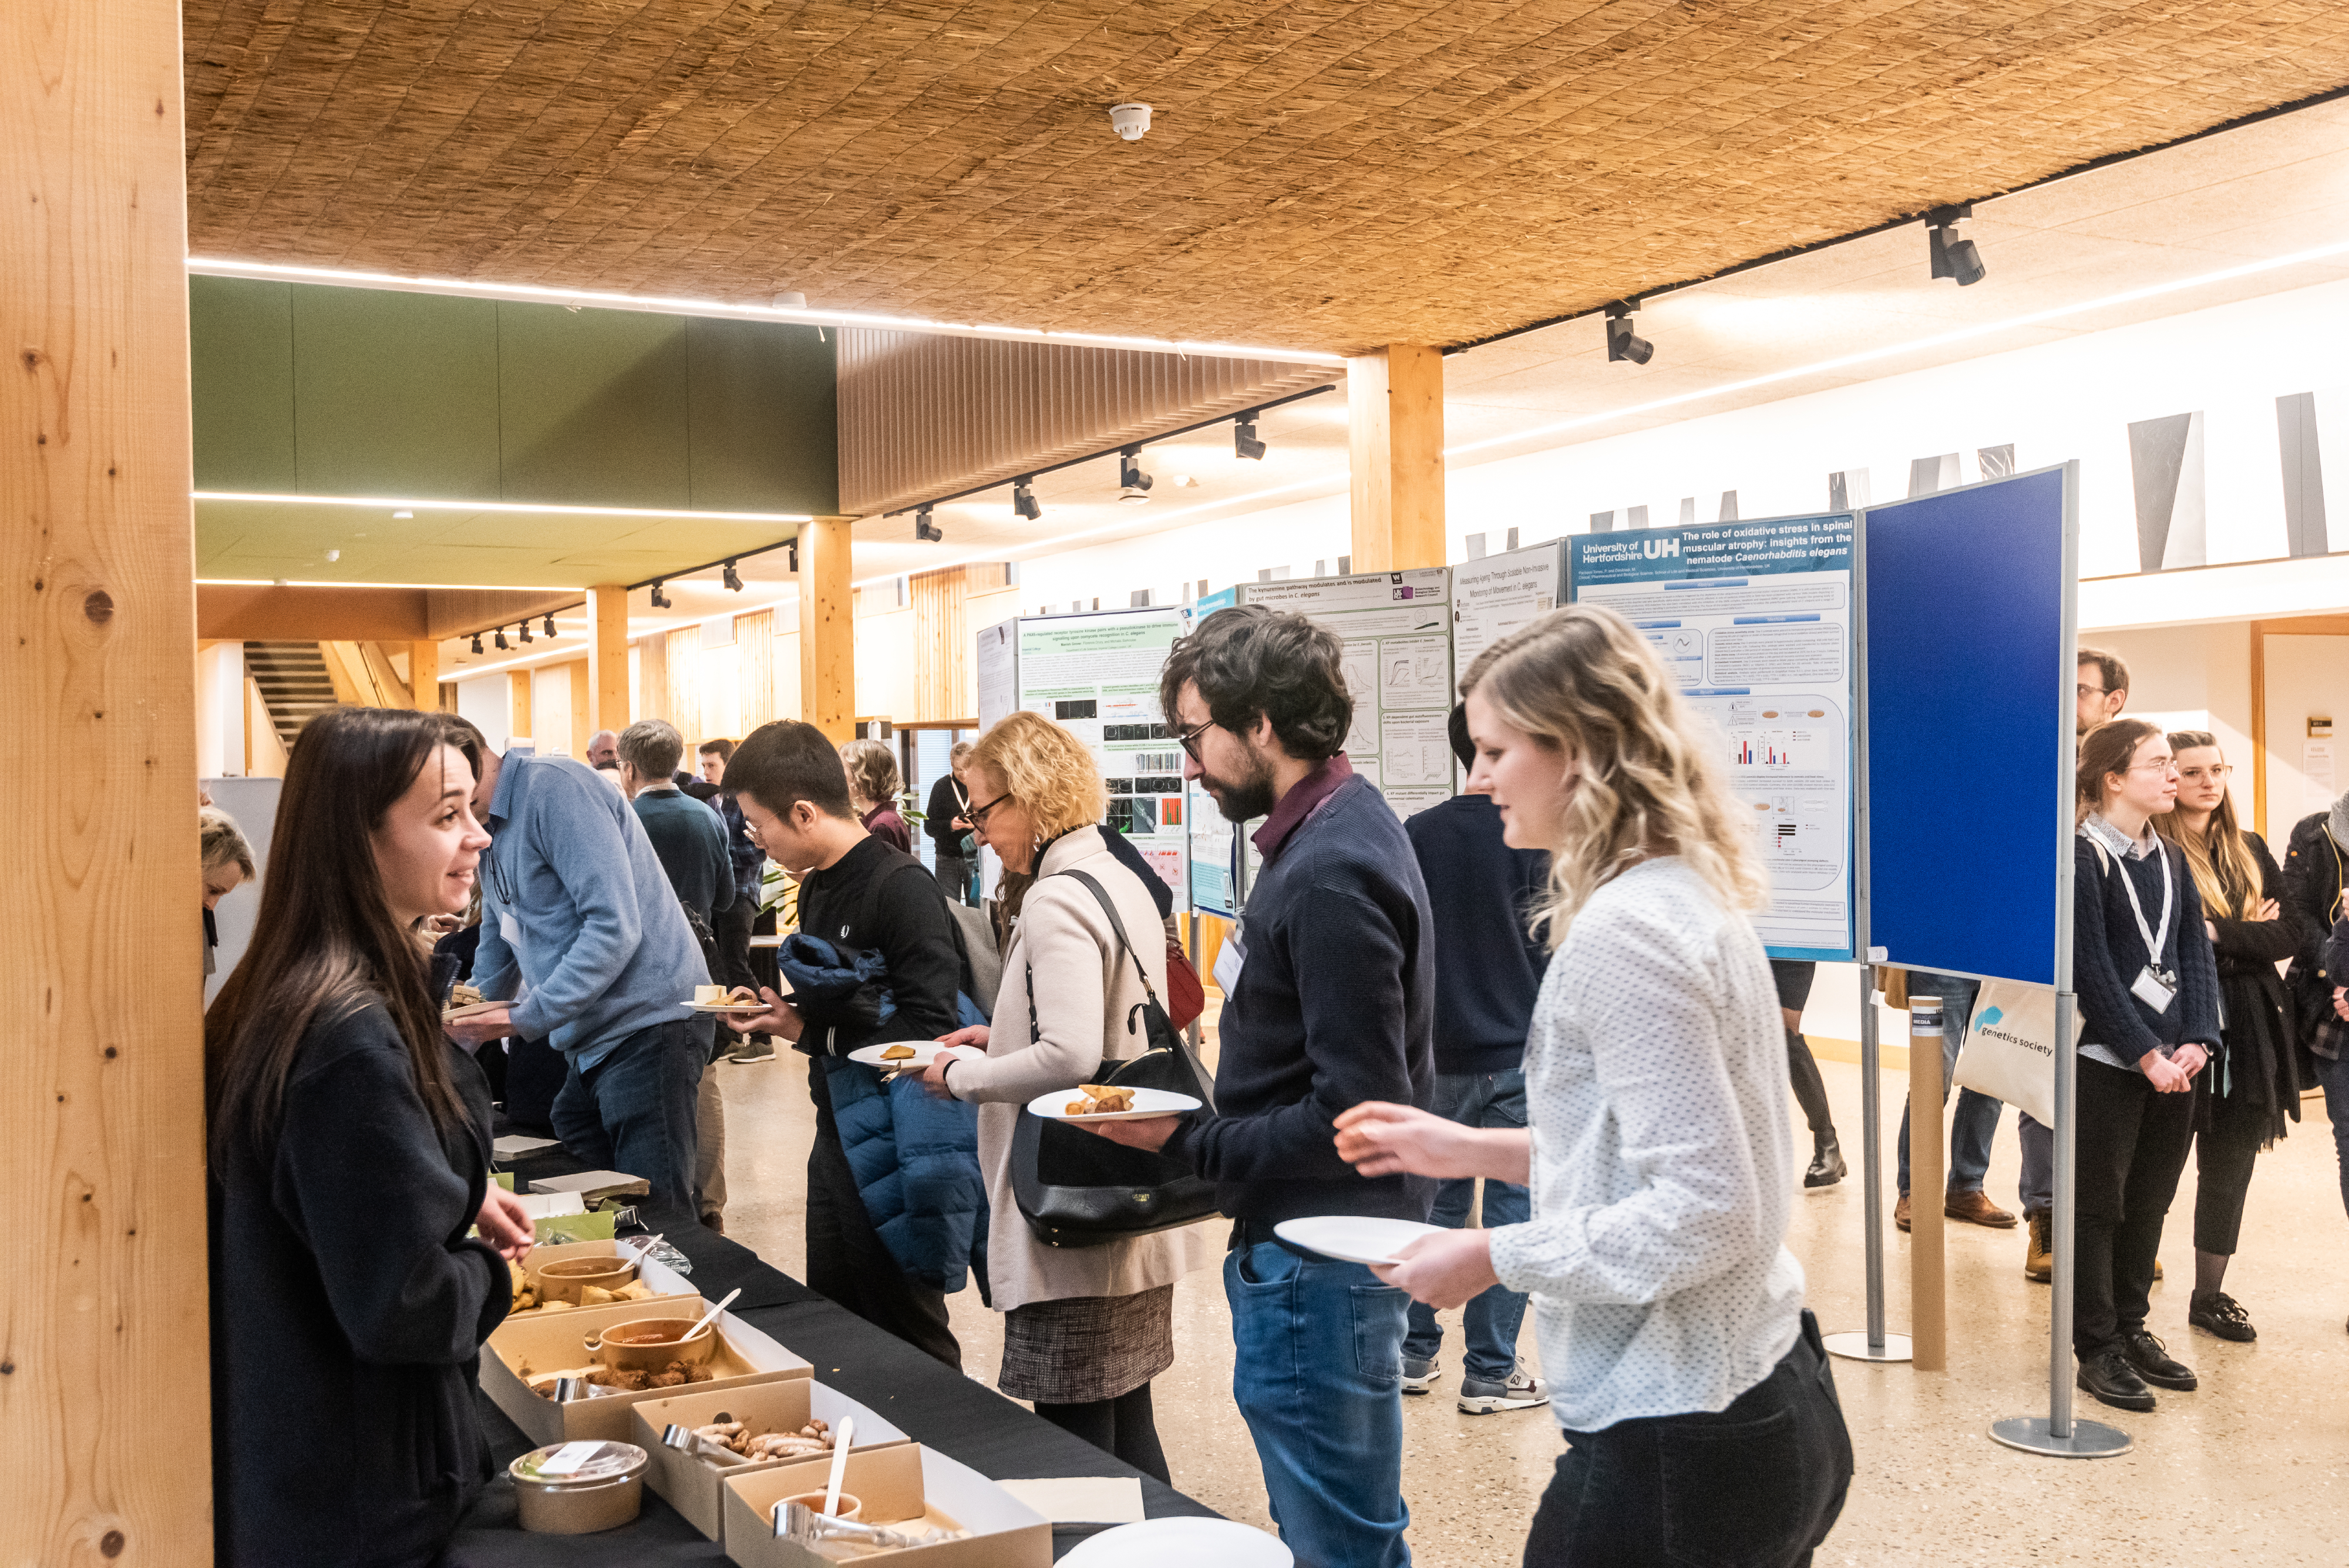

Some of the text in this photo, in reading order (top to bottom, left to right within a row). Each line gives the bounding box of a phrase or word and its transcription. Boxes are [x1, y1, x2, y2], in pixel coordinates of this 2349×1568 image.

[1682, 520, 1853, 541] The role of oxidative stress in spinal
[1583, 541, 1638, 554] University of
[1644, 538, 1680, 560] UH
[1682, 533, 1852, 553] muscular atrophy: insights from the
[1583, 551, 1643, 563] Hertfordshire
[1687, 547, 1847, 565] nematode Caenorhabditis elegans
[1258, 586, 1285, 594] kynurenine
[1981, 1027, 2053, 1058] genetics society
